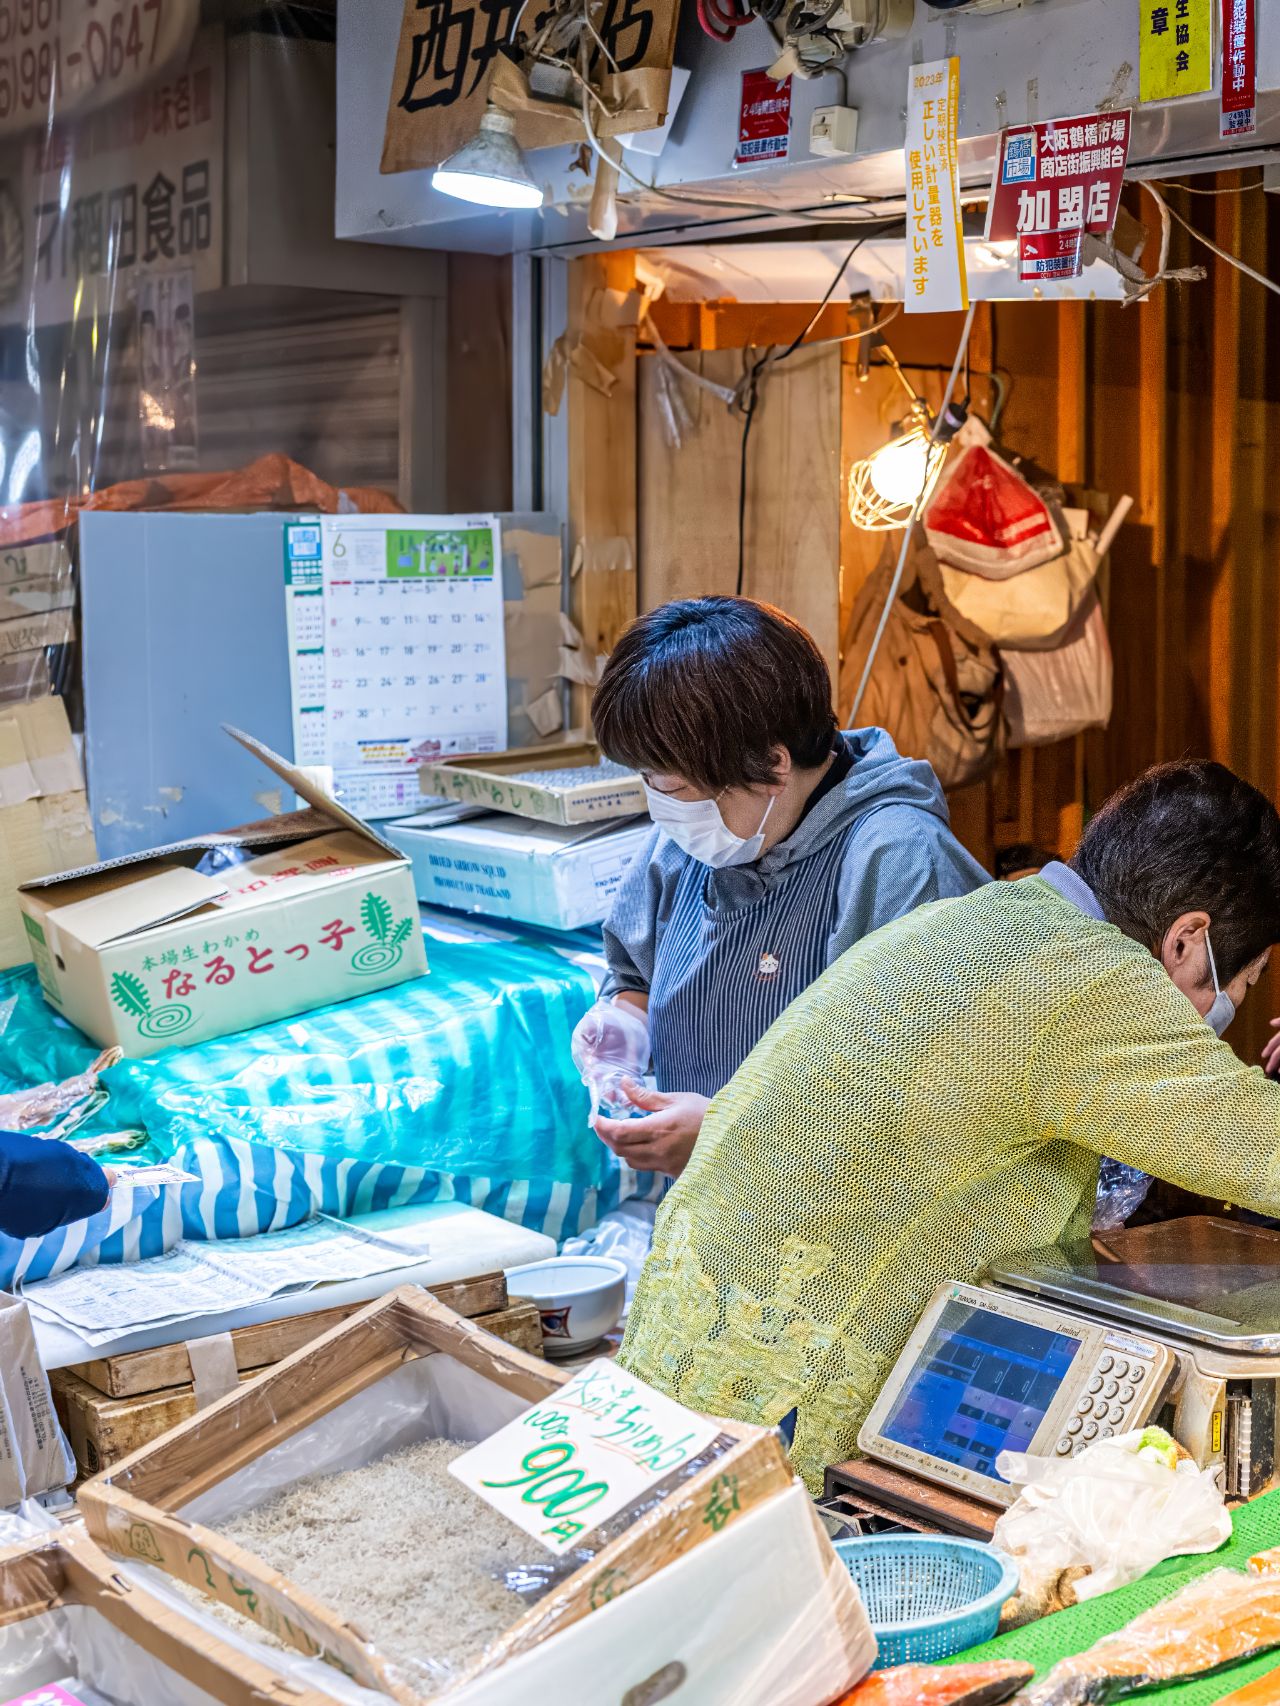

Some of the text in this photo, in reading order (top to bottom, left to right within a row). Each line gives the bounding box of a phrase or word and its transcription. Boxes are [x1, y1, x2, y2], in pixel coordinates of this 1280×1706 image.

[1040, 119, 1126, 153] 大阪鶴橋市場
[922, 100, 944, 247] 正しい計量器を
[1040, 145, 1125, 179] 商店街振興組合
[909, 149, 929, 296] 使用しています
[1016, 181, 1111, 232] 加盟店
[332, 533, 347, 558] 6
[142, 927, 260, 973] 本場生わかめ
[162, 918, 356, 1000] なるとっ子
[1056, 1323, 1081, 1337] Limited
[480, 1442, 609, 1519] 900
